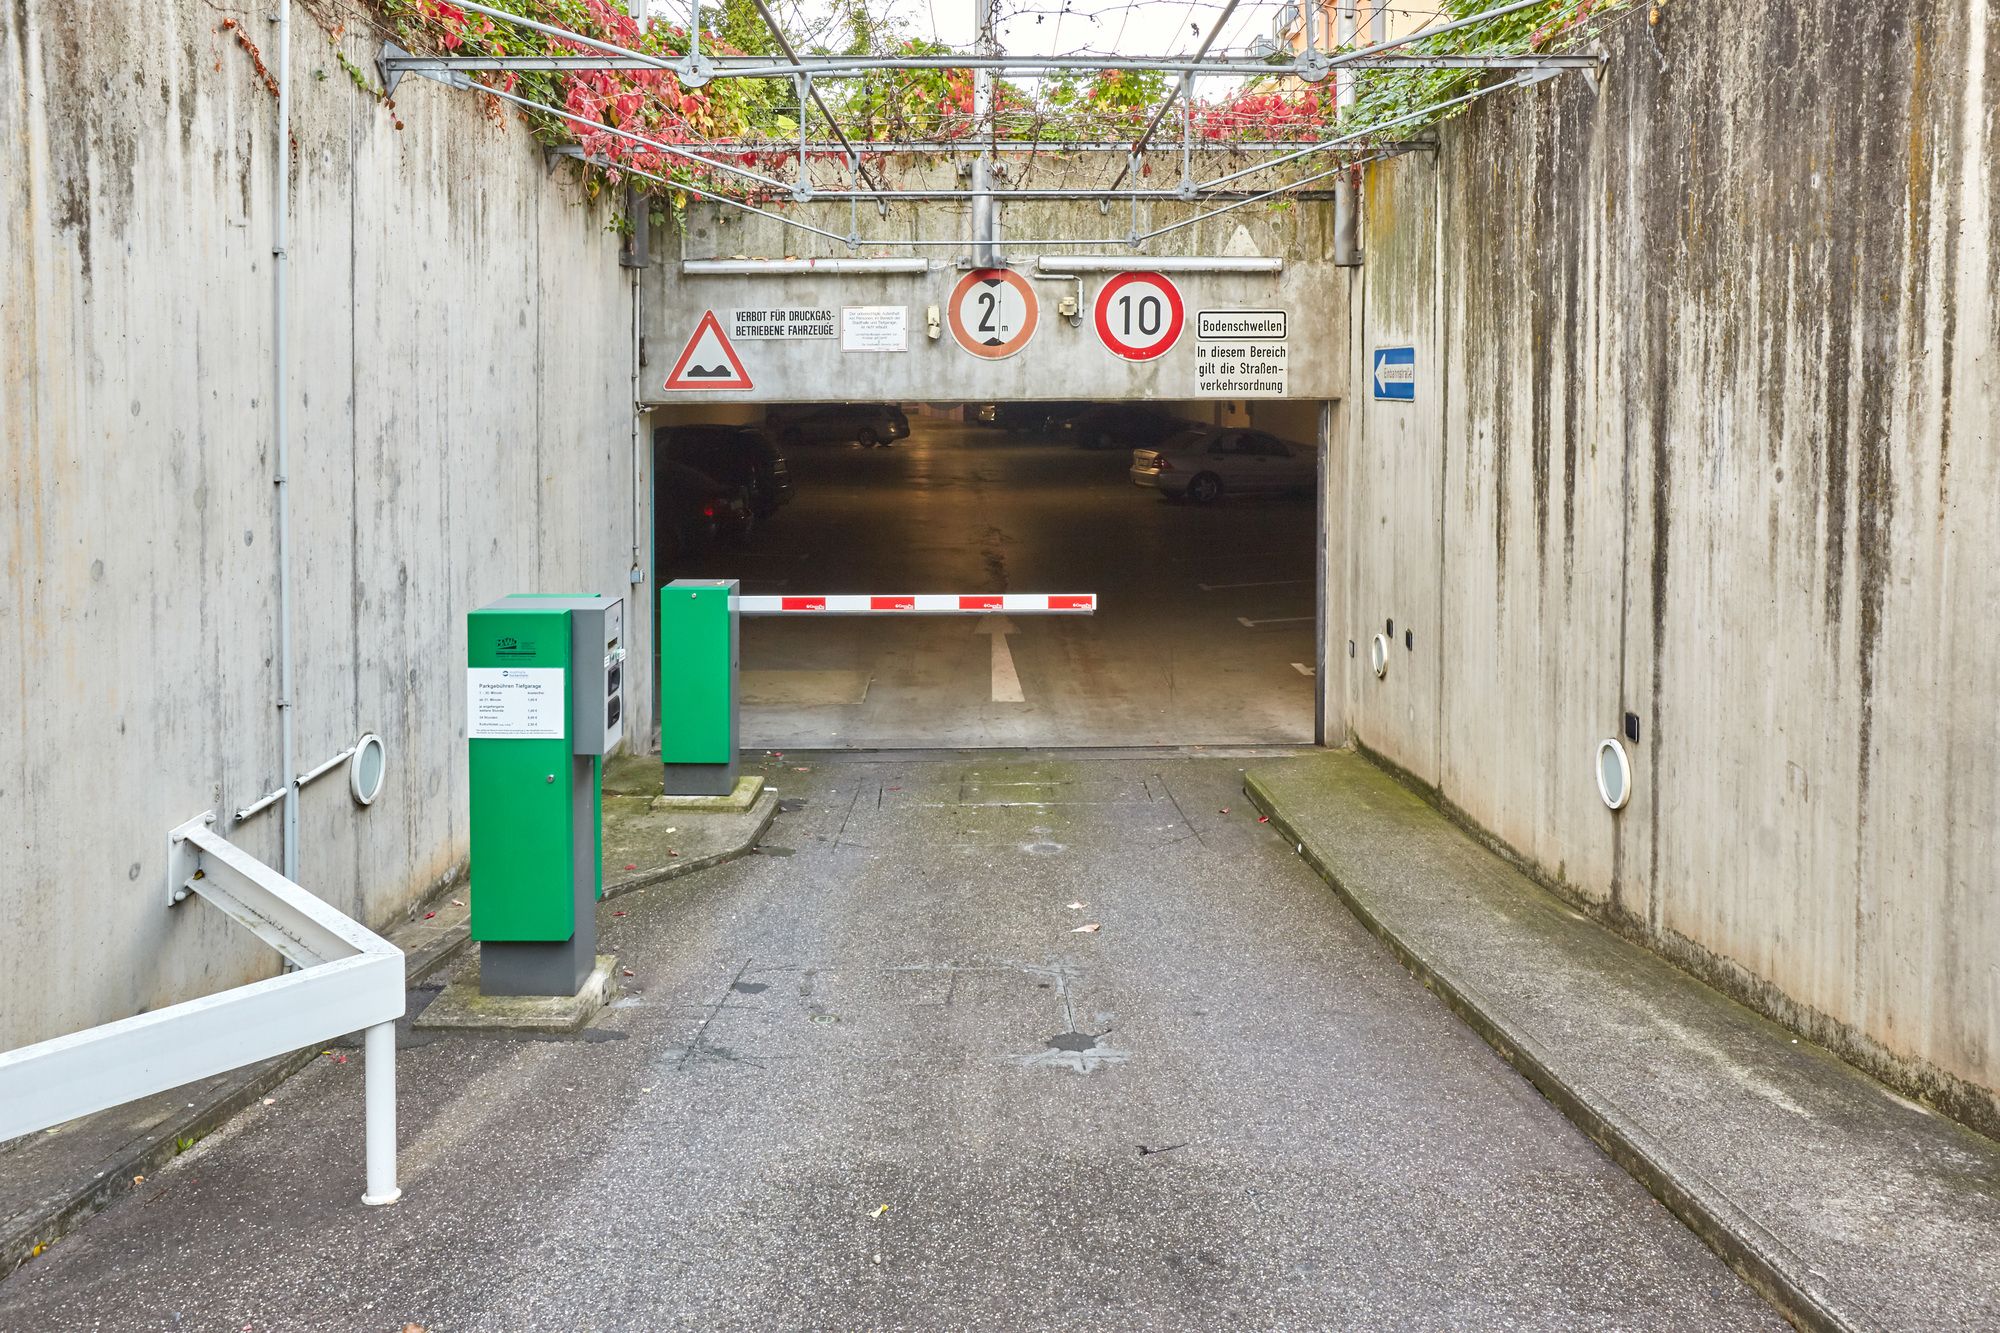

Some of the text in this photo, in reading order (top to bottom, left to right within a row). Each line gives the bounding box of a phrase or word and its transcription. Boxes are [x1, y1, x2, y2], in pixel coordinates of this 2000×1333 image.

[735, 309, 836, 322] VERBOT FÜR DRUCKGAS-
[978, 292, 1009, 332] 2 m
[1118, 295, 1161, 335] 10
[735, 324, 834, 336] BETRIEBENE FAHRZEUGE
[1202, 319, 1283, 332] Bodenschwellen
[1197, 346, 1286, 358] In diesem Bereich
[1199, 362, 1284, 376] gilt die Straßen-
[1199, 379, 1283, 393] verkehrsordnung
